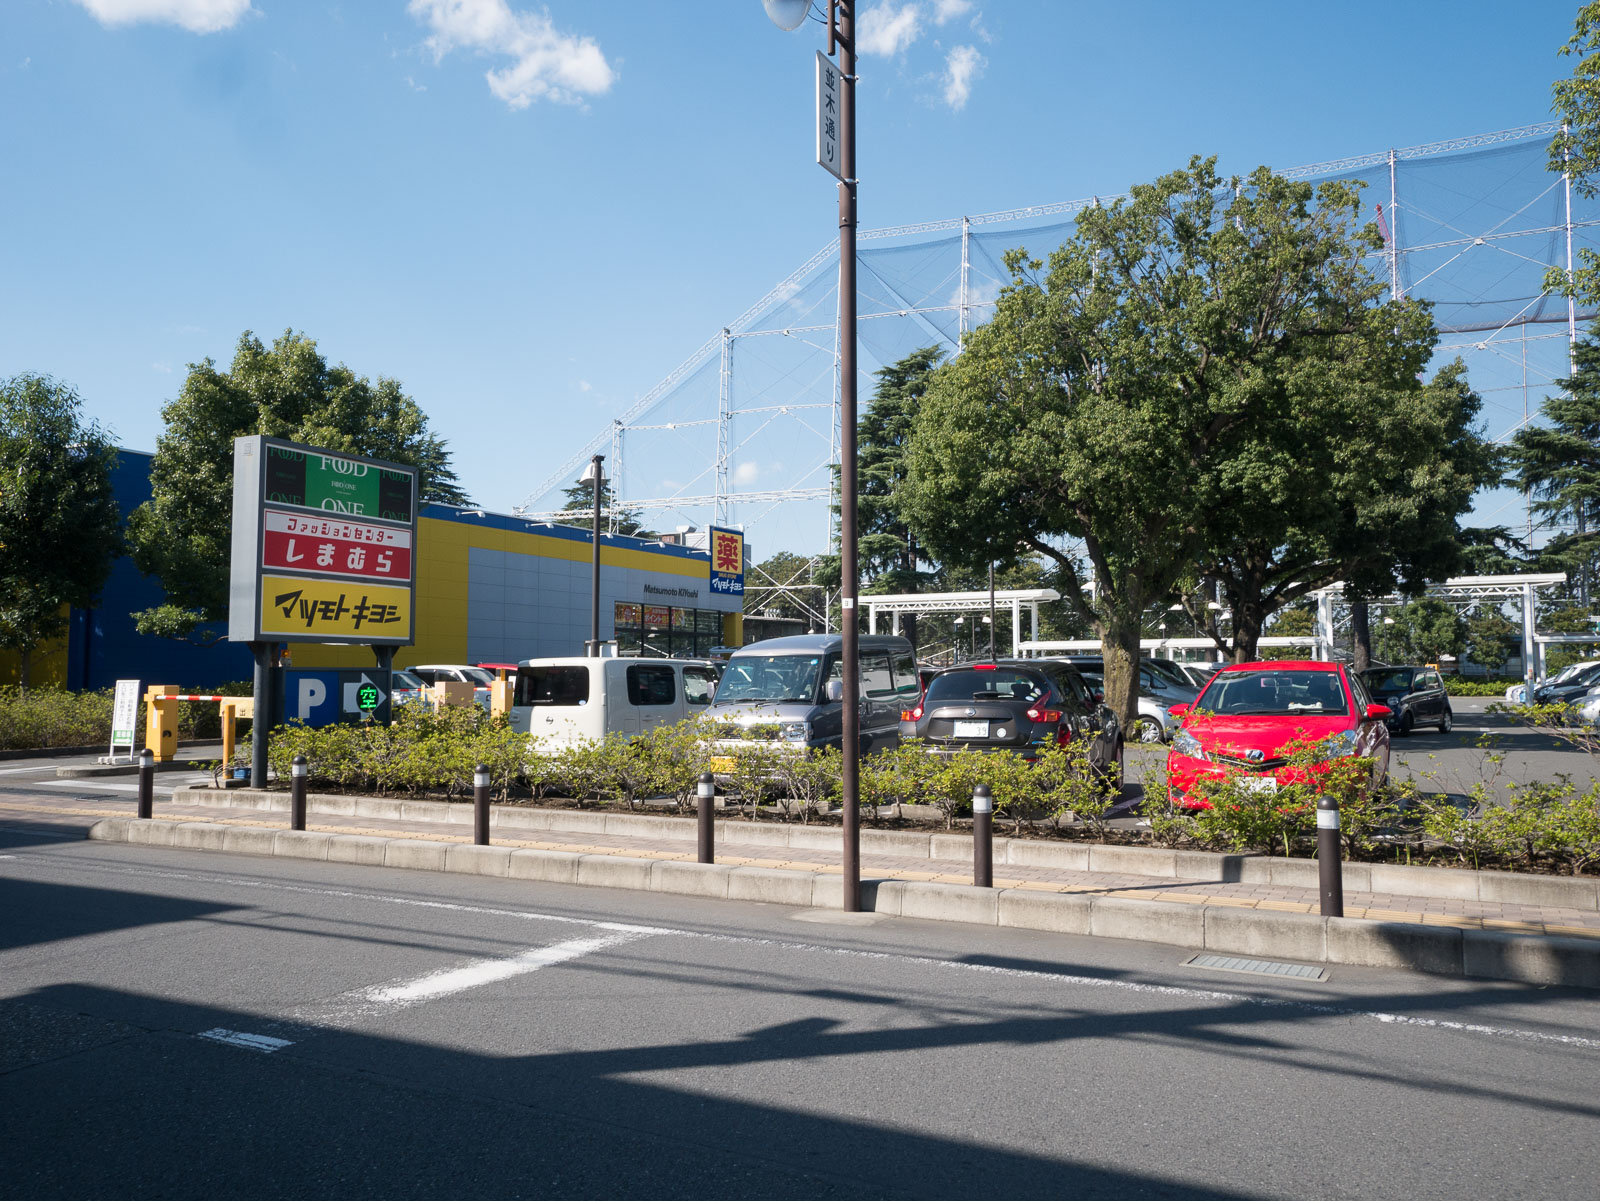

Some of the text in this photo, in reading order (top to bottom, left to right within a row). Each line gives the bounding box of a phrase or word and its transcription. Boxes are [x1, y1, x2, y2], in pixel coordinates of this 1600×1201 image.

[825, 68, 835, 163] 並木通り
[320, 456, 368, 477] FOOD
[321, 497, 365, 516] ONE
[287, 517, 394, 543] ファッションセンター
[286, 538, 394, 573] しまむら
[717, 534, 738, 571] 薬
[643, 583, 677, 596] Matsumoto
[712, 577, 743, 593] マツモトキヨシ
[275, 589, 402, 630] マツモトキヨシ
[298, 678, 327, 719] P
[360, 686, 377, 709] 空
